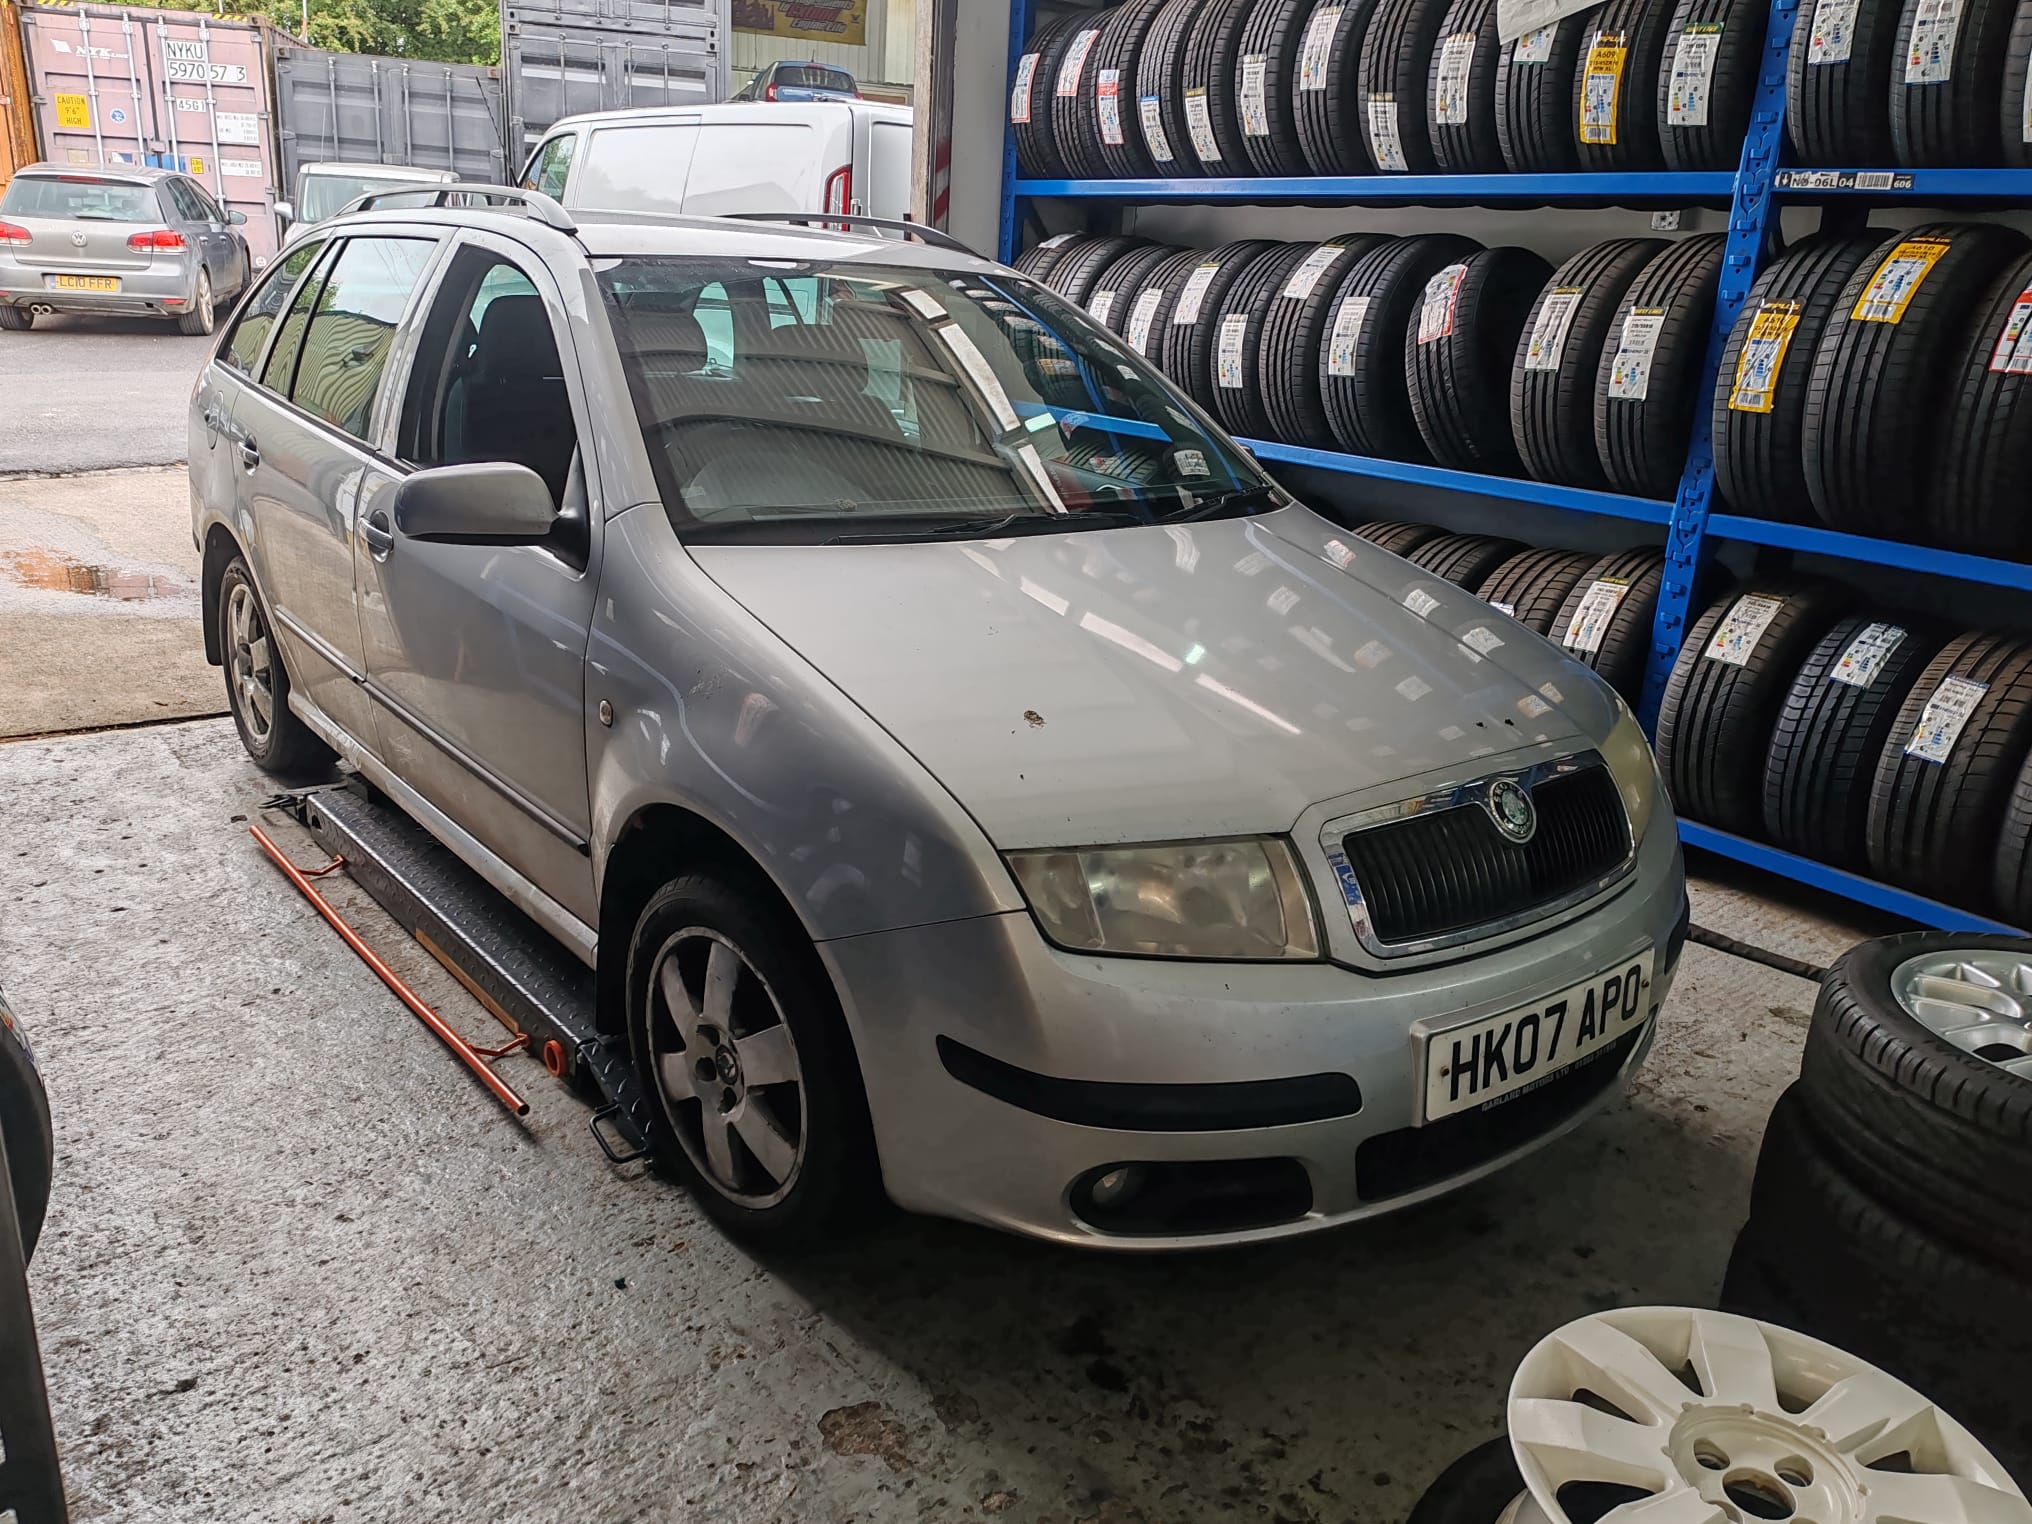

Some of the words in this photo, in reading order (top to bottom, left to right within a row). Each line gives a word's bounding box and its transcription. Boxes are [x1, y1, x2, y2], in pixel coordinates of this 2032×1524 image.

[167, 42, 204, 59] NYKU
[236, 67, 246, 81] 3
[57, 96, 86, 105] CAUTION
[66, 117, 82, 125] HIGH
[1449, 1000, 1568, 1102] HK07
[1576, 964, 1642, 1048] APO
